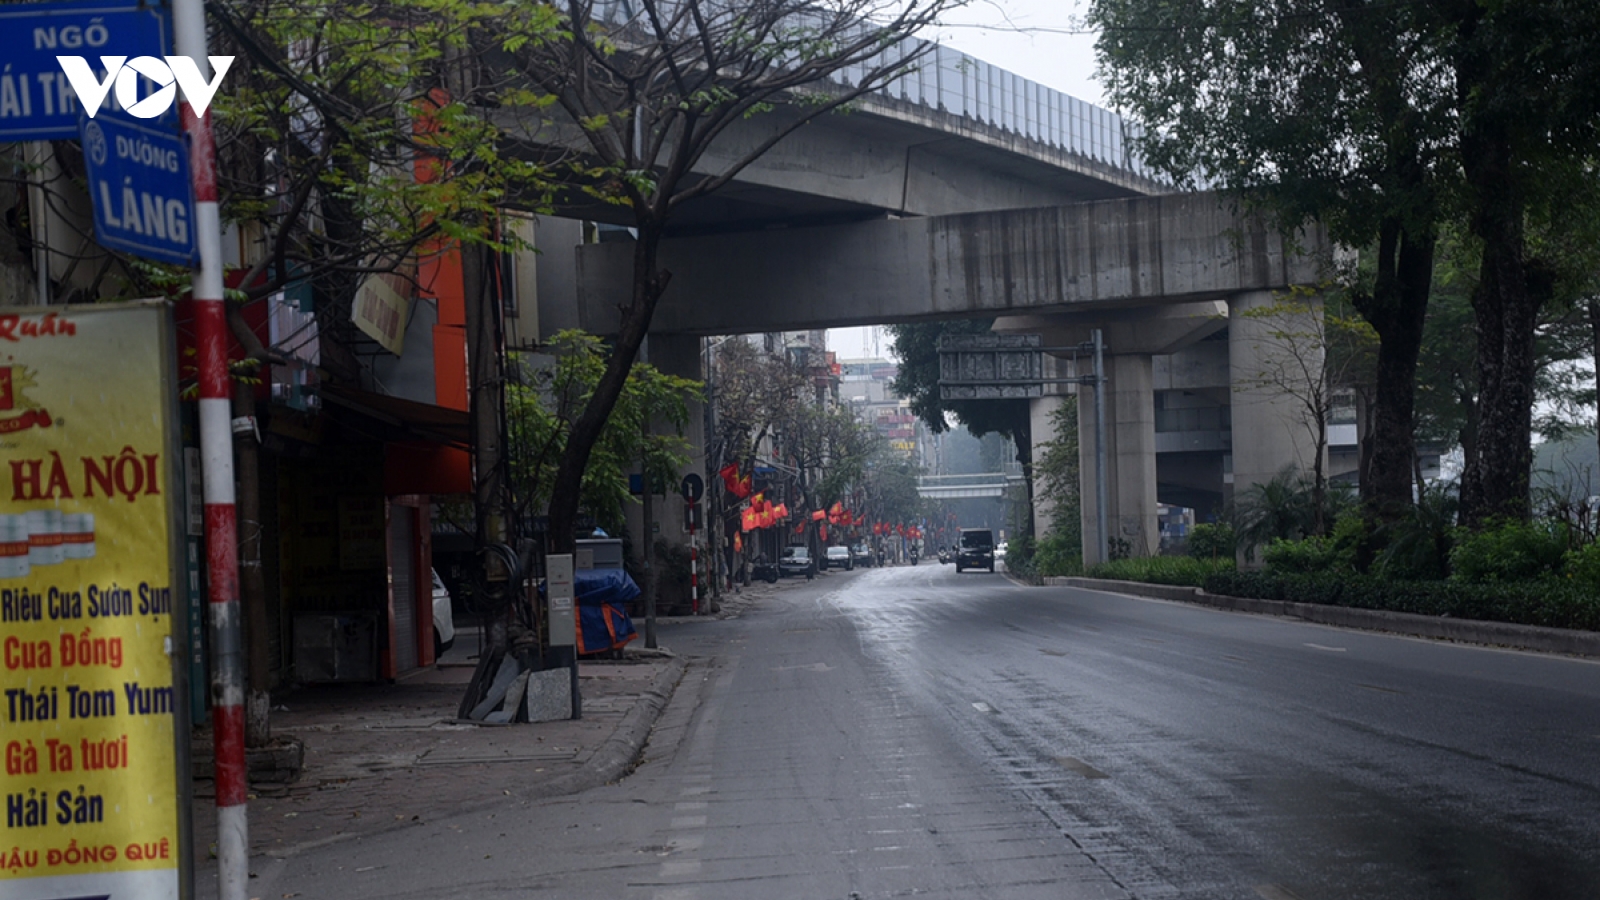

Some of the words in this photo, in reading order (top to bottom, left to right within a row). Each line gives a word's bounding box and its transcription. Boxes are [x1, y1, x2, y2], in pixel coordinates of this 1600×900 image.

[33, 18, 109, 49] NGÕ
[100, 176, 188, 244] LÁNG
[9, 450, 73, 500] HÀ
[81, 445, 160, 502] NỘI
[2, 587, 42, 622] Riêu
[48, 587, 82, 619] Cua
[88, 583, 132, 617] Sườn
[138, 582, 171, 622] Sụn
[4, 636, 52, 669] Cua
[60, 628, 123, 668] Đồng
[5, 687, 57, 722] Thái
[66, 686, 115, 719] Tom
[124, 682, 174, 715] Yum
[6, 740, 38, 775] Gà
[46, 739, 72, 773] Ta
[81, 735, 128, 771] tươi
[7, 788, 47, 827] Hải
[56, 785, 103, 824] Sản
[47, 839, 117, 866] ĐỒNG
[125, 837, 169, 860] QUÊ
